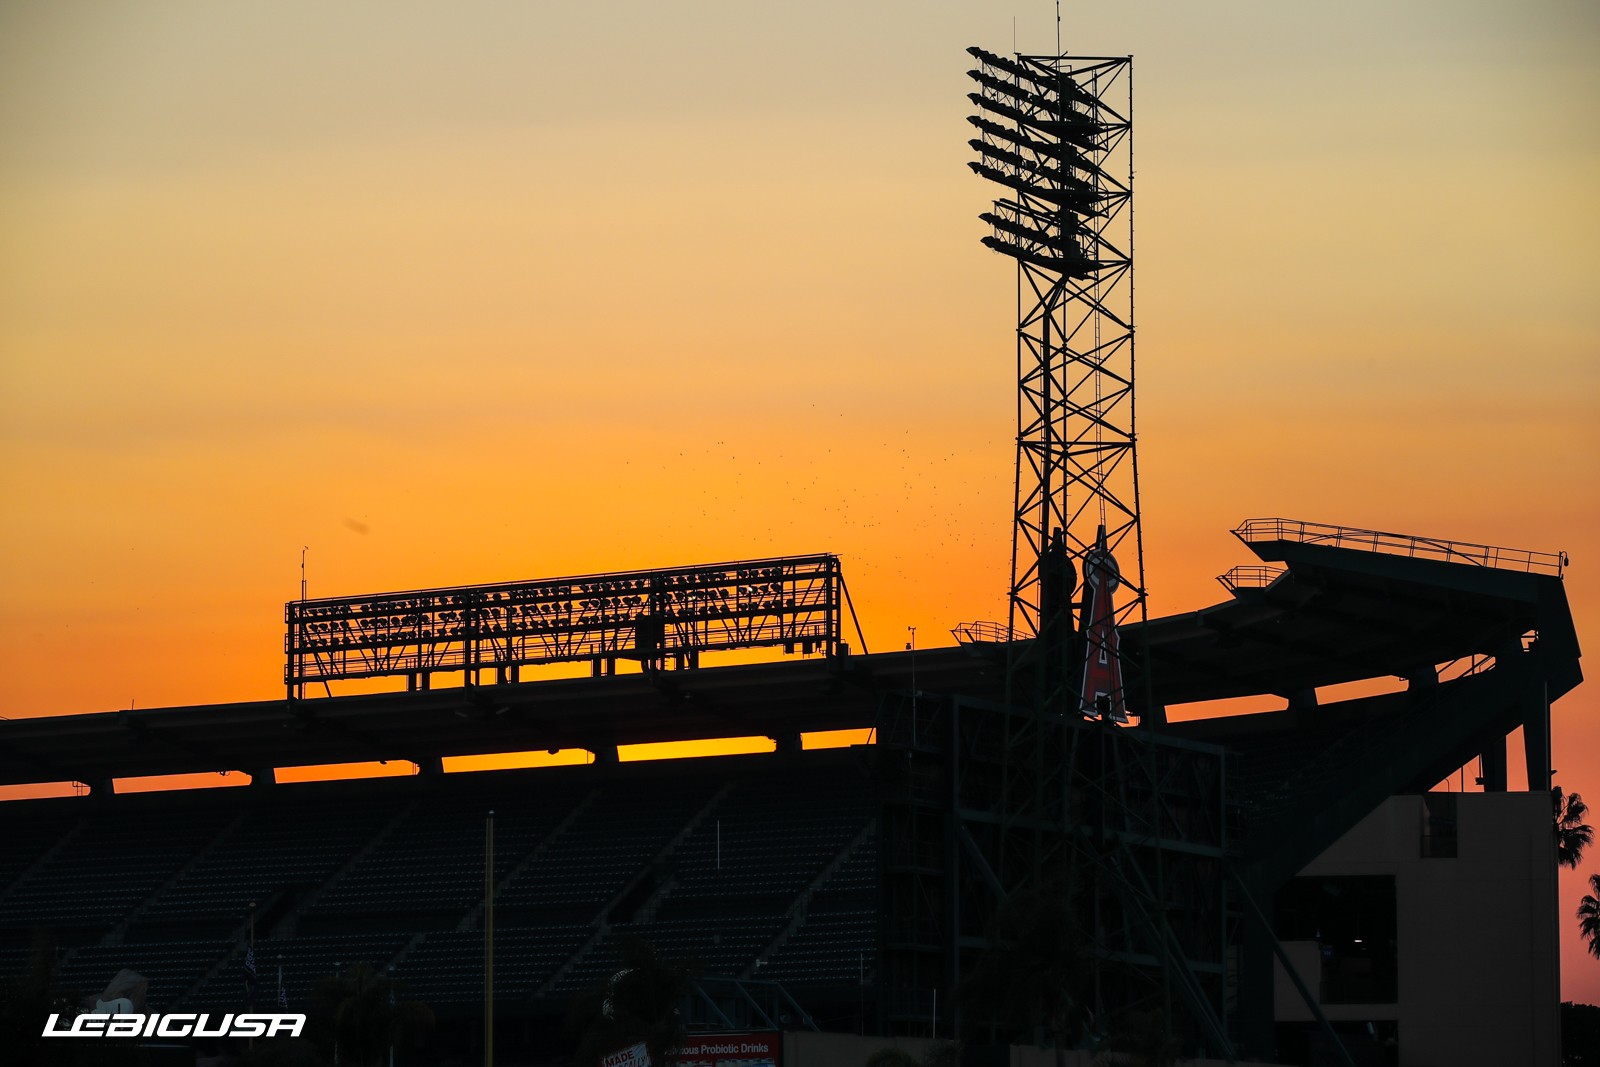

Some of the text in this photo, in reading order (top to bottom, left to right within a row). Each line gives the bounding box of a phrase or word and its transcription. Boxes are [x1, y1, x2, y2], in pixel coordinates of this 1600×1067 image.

[700, 1043, 739, 1055] Probiotic
[740, 1042, 769, 1054] Drinks
[605, 1050, 635, 1067] MADE
